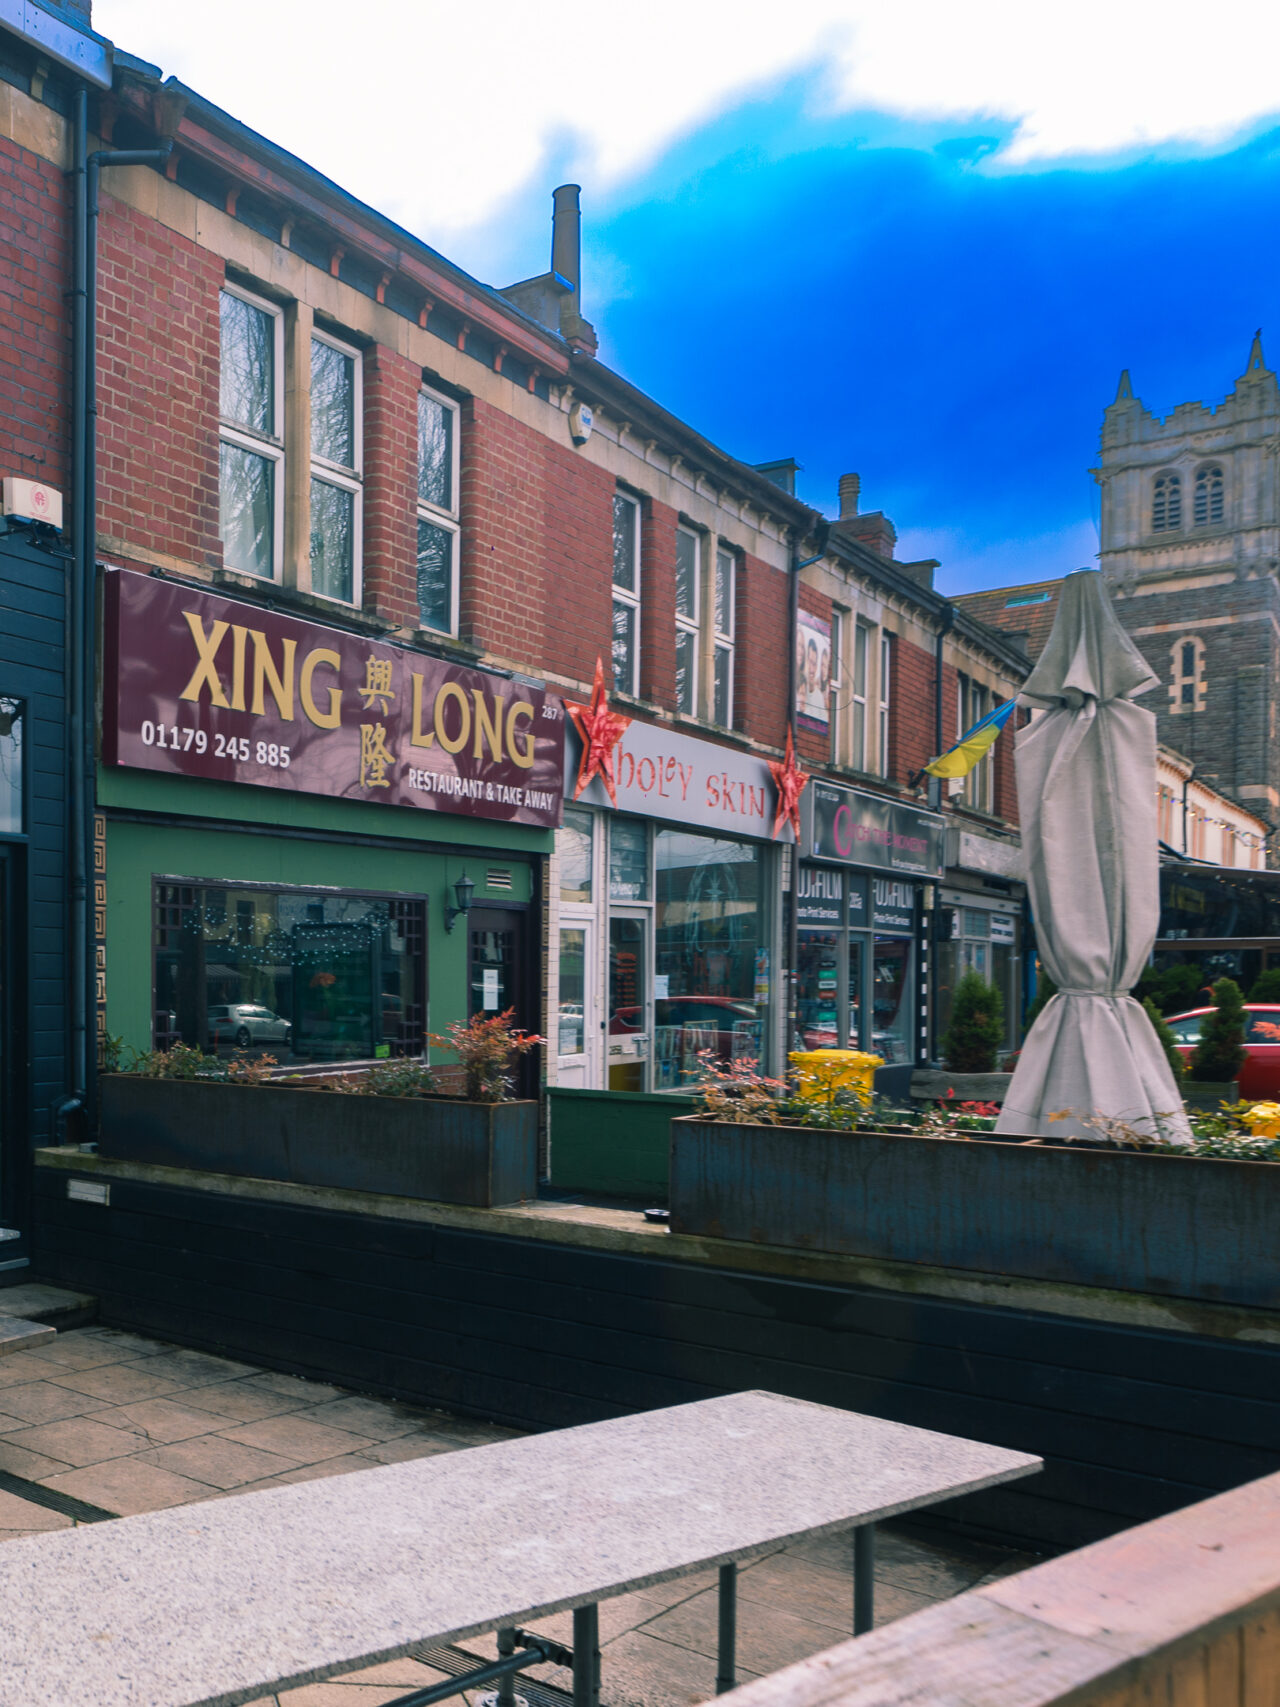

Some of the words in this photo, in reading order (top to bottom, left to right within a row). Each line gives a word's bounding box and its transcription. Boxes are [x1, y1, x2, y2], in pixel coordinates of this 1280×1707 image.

[180, 611, 342, 730] XING
[410, 672, 536, 769] LONG
[541, 704, 558, 721] 287
[141, 720, 207, 755] 01179
[213, 732, 250, 762] 245
[255, 740, 291, 768] 885
[408, 768, 484, 802] RESTAURANT
[486, 783, 494, 801] &
[496, 785, 523, 806] TAKE
[523, 790, 553, 811] AWAY
